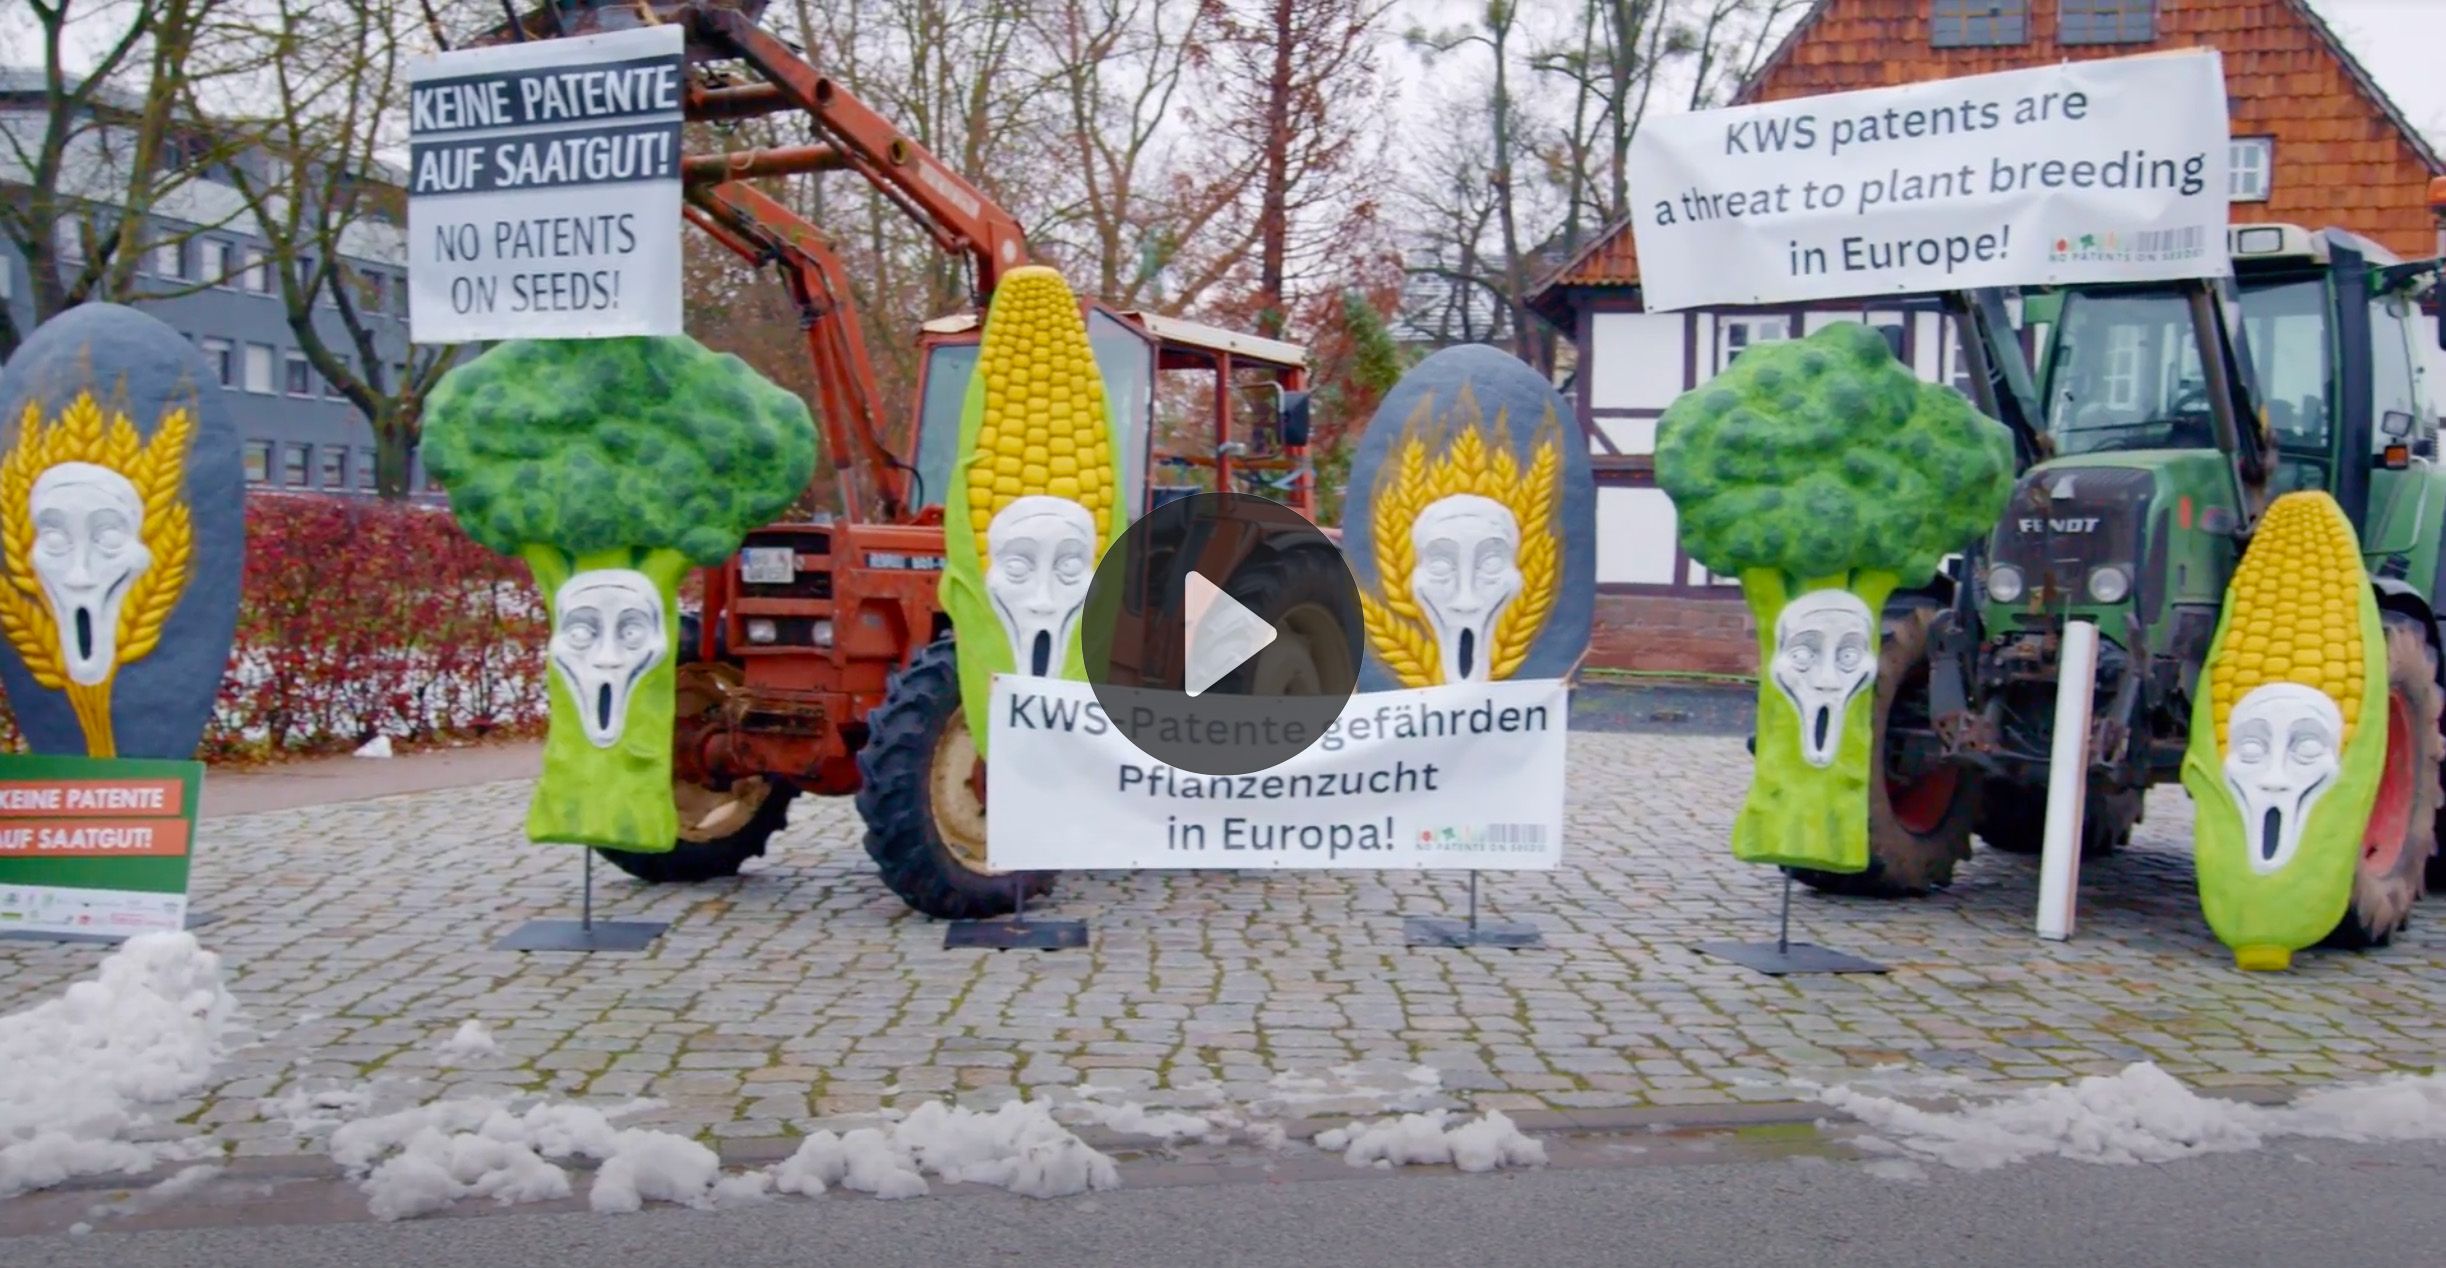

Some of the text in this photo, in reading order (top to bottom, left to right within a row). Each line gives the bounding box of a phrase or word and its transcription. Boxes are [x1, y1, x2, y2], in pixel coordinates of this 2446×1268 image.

[413, 65, 677, 130] KEINE PATENTE
[1725, 90, 2088, 156] KWS patents are
[416, 131, 671, 192] AUF SAATGUT!
[1655, 149, 2207, 226] a threat to plant breeding
[434, 213, 637, 262] NO PATENTS
[1789, 224, 2011, 276] in Europe!
[450, 269, 621, 314] ON SEEDS!
[2019, 517, 2100, 533] FENDT
[1008, 692, 1548, 751] KWS-Patente gefährden
[0, 788, 164, 809] KEINE PATENTE
[1119, 760, 1439, 801] Pflanzenzucht
[38, 828, 153, 849] SAATGUT!
[1167, 814, 1394, 861] in Europa!
